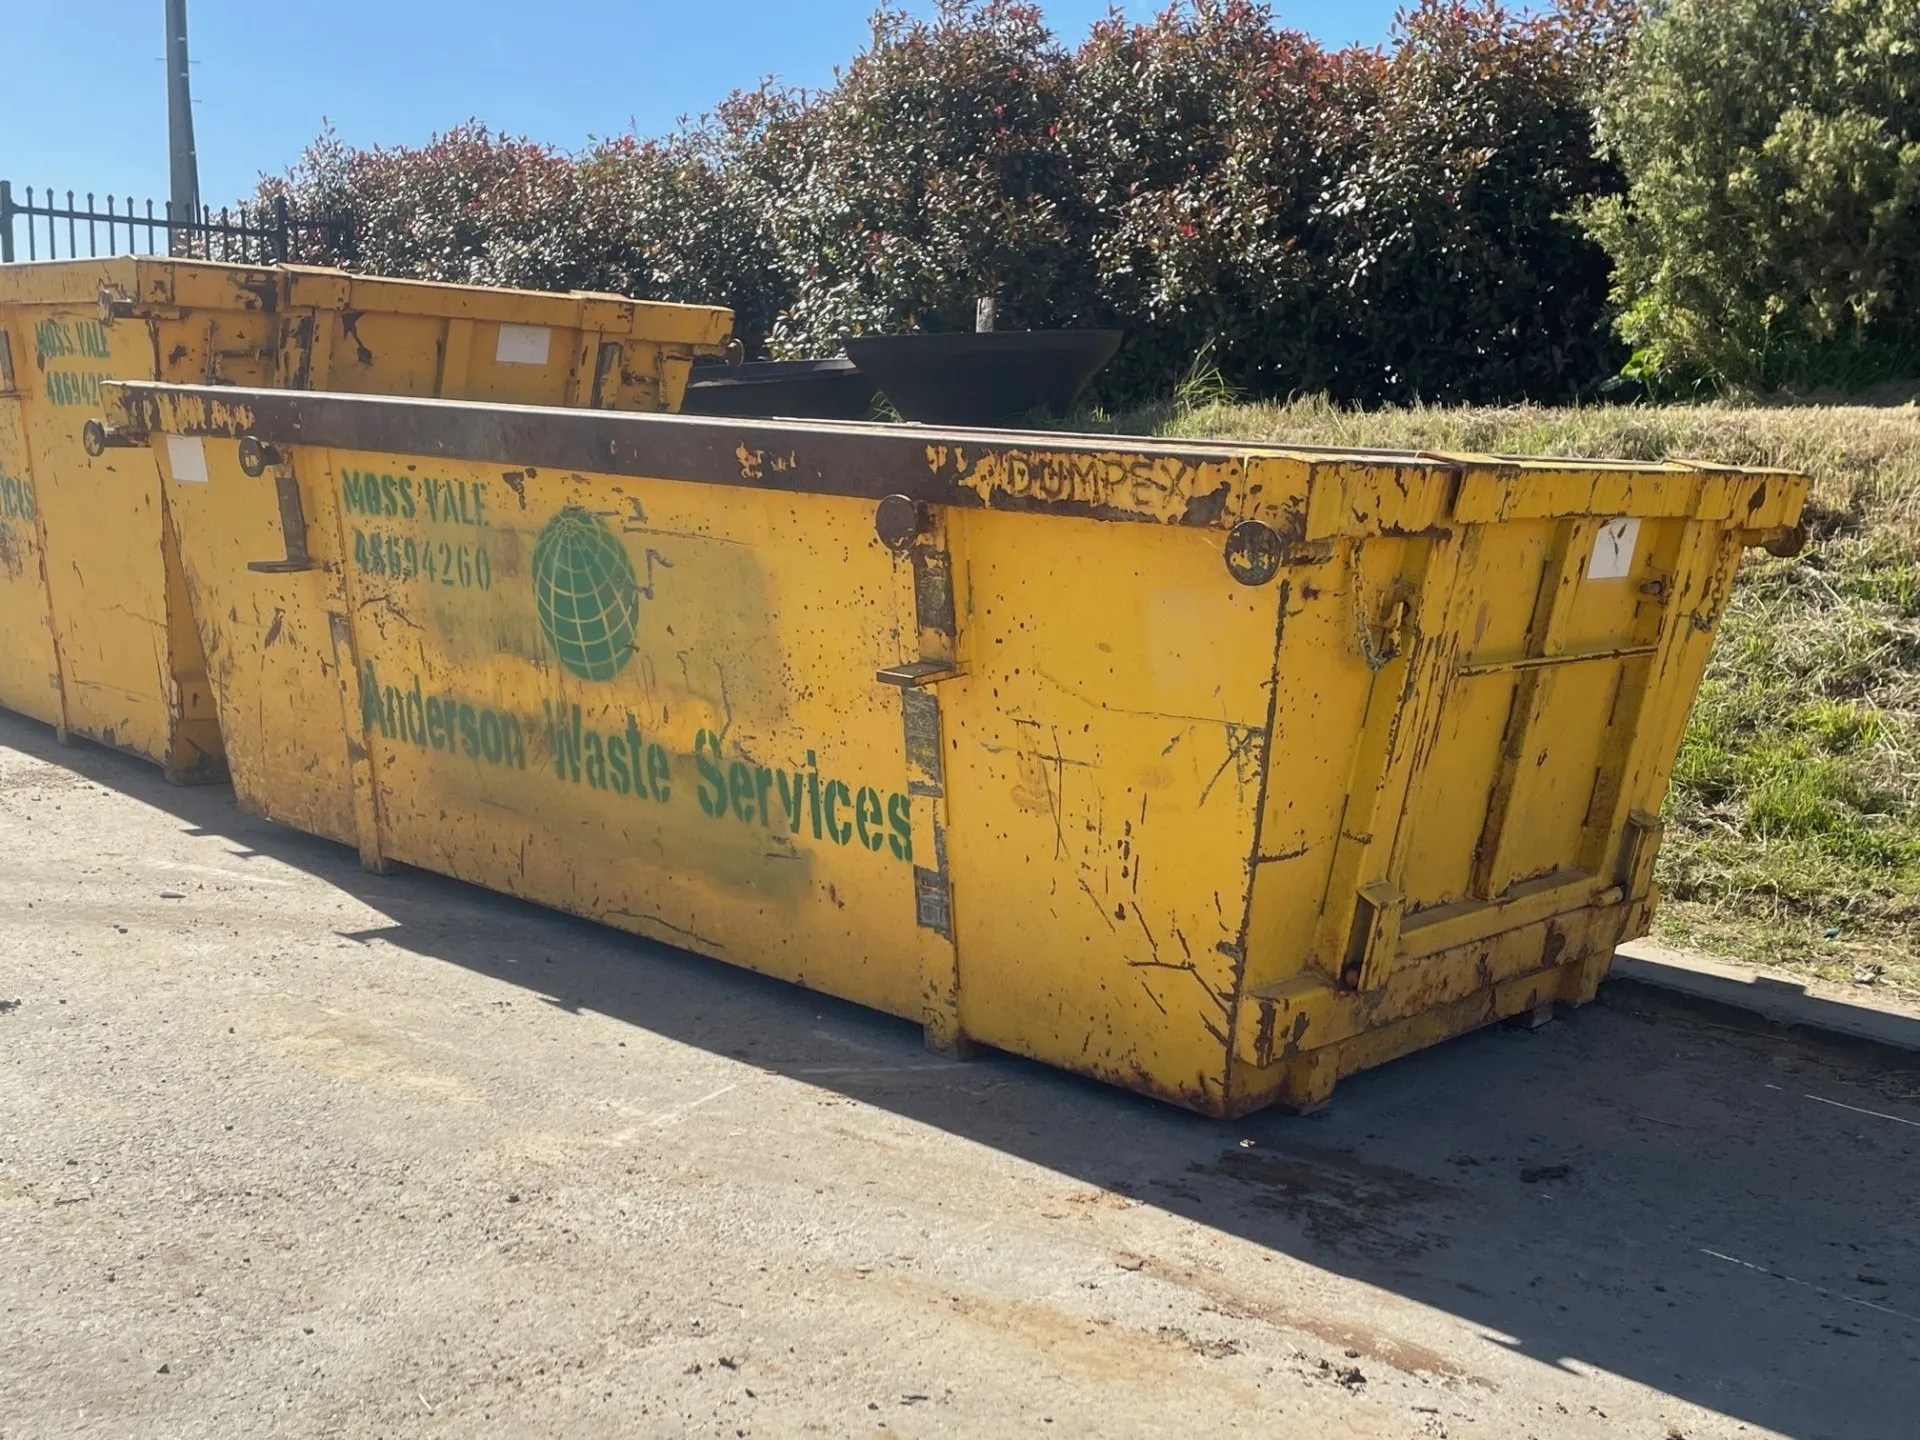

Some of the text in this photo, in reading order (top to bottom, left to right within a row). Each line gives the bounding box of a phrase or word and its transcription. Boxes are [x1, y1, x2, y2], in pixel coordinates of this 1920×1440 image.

[35, 319, 111, 358] MOSS VALE
[46, 371, 113, 407] 486942
[341, 468, 487, 527] MOSS VALE
[362, 660, 914, 862] Anderson Waste Services
